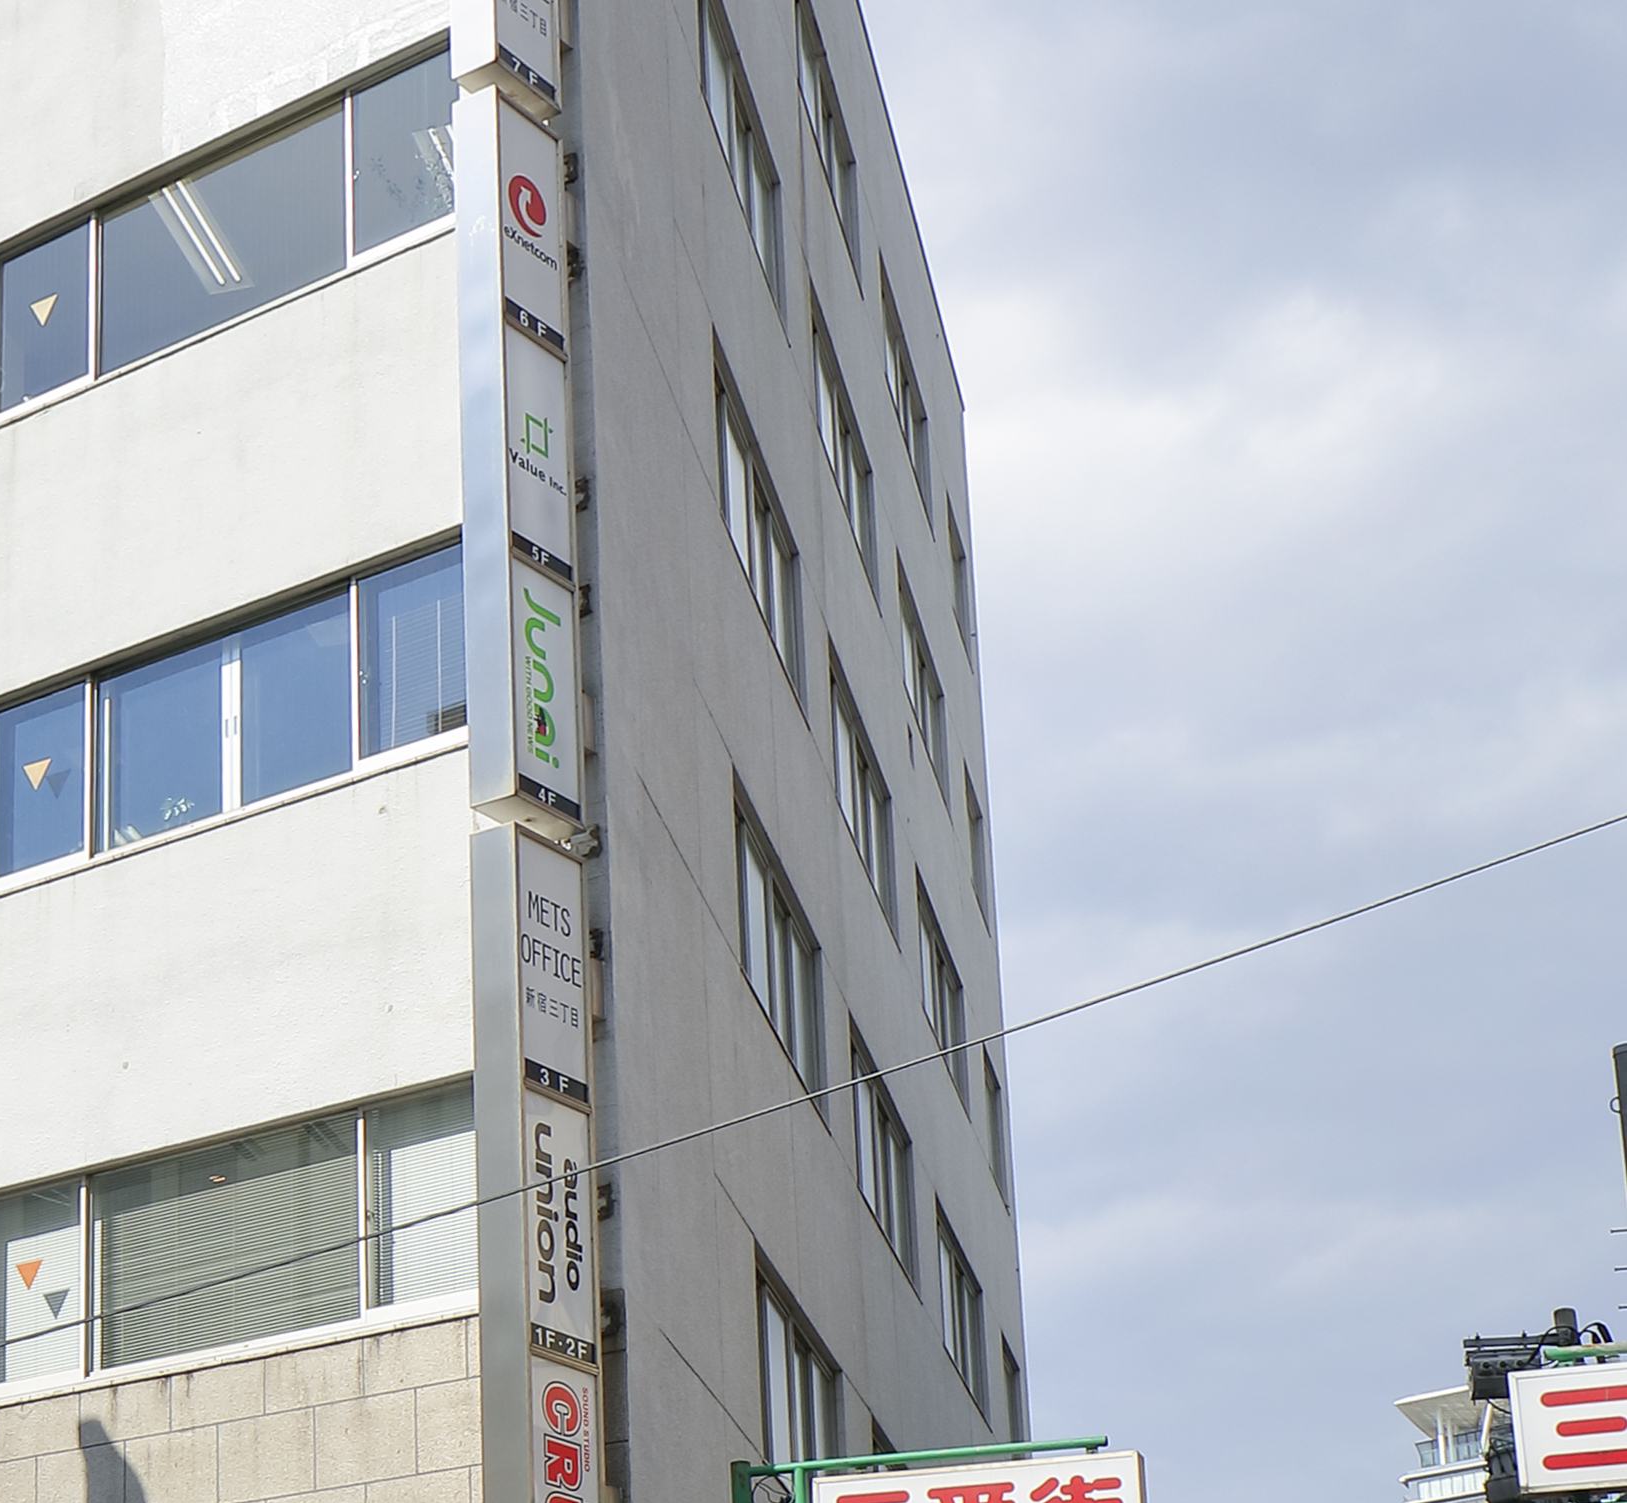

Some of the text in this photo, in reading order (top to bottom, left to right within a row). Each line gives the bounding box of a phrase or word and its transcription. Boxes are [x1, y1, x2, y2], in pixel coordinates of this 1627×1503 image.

[504, 225, 558, 271] eXnetcom
[508, 447, 568, 497] Value Inc.
[531, 545, 550, 567] 5F
[538, 787, 556, 807] 4F
[528, 890, 572, 938] METS
[521, 933, 583, 989] OFFICE
[525, 987, 579, 1028] 新宿三丁目
[534, 1121, 559, 1304] union
[562, 1158, 583, 1292] audio
[581, 1386, 591, 1473] SOUND STUDIO
